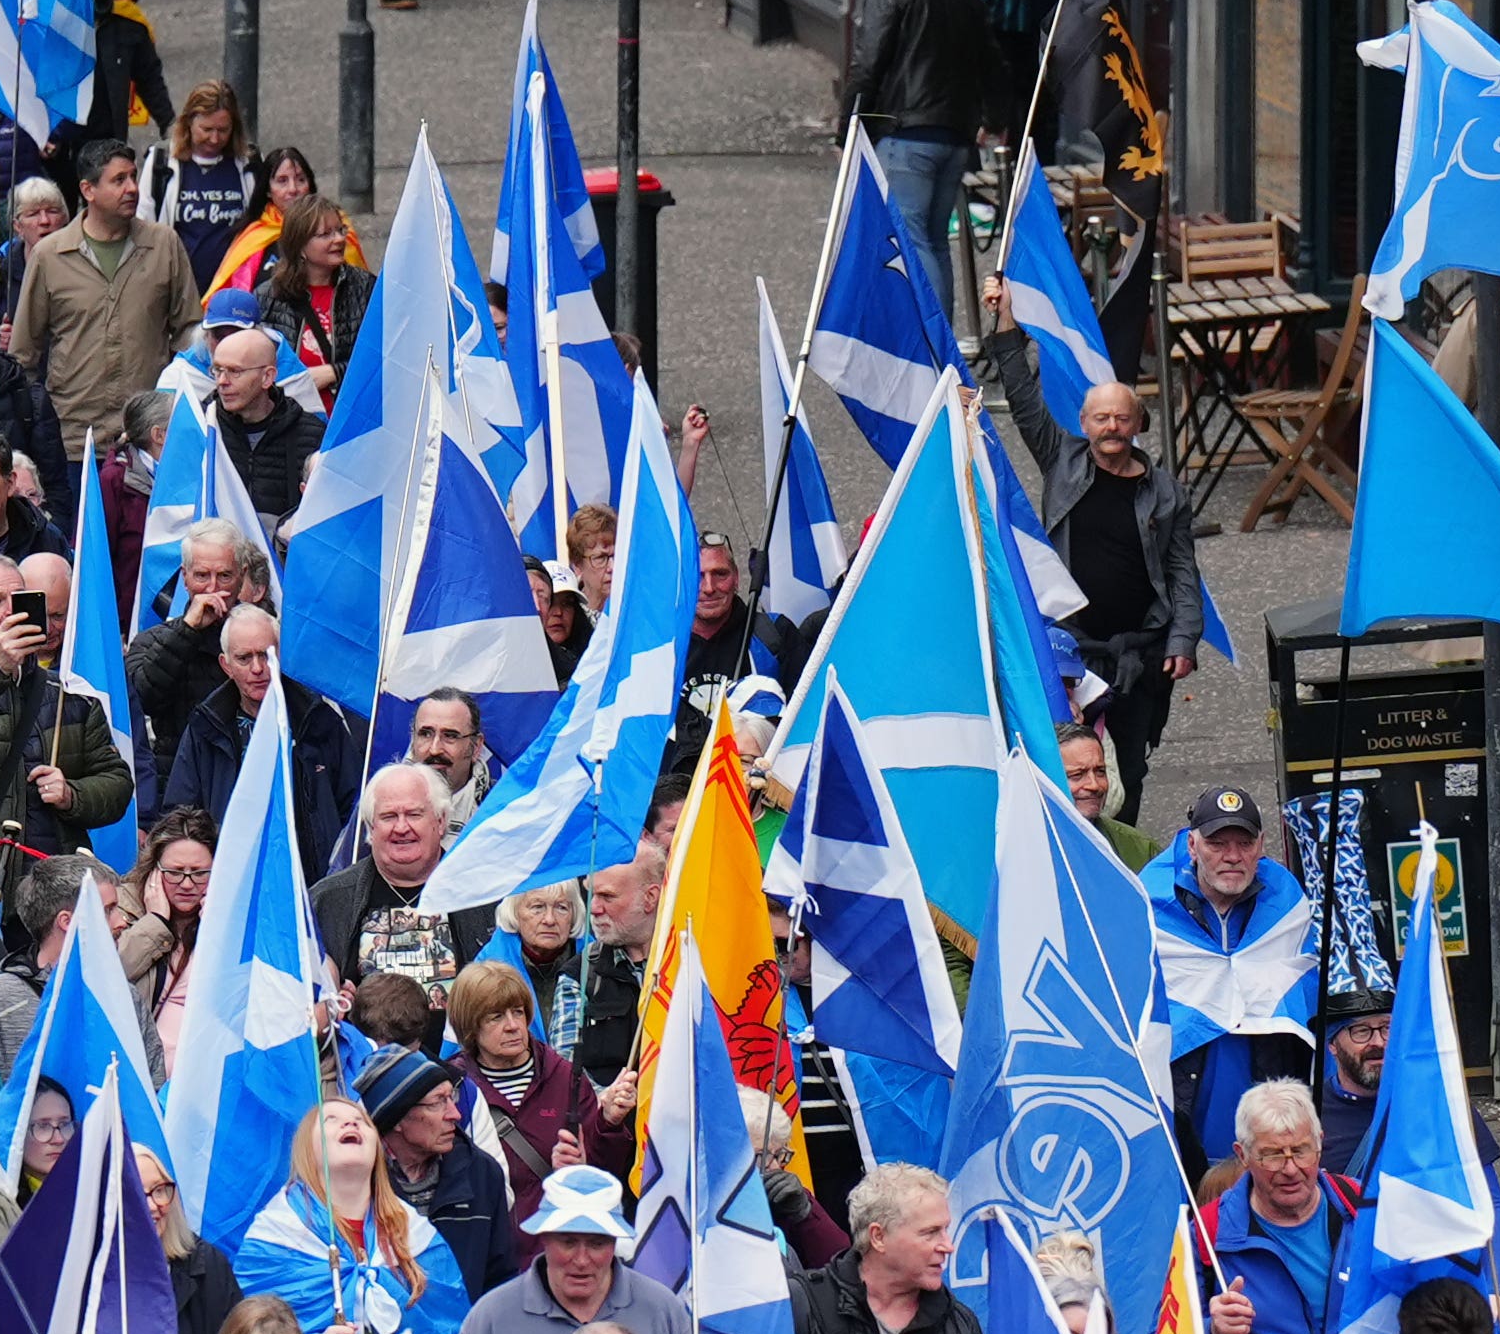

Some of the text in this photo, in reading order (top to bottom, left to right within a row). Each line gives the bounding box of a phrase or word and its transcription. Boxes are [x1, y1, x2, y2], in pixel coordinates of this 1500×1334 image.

[201, 190, 223, 201] YES
[183, 202, 206, 222] Can
[1377, 708, 1449, 725] LITTER &
[1367, 731, 1463, 751] DOG WASTE
